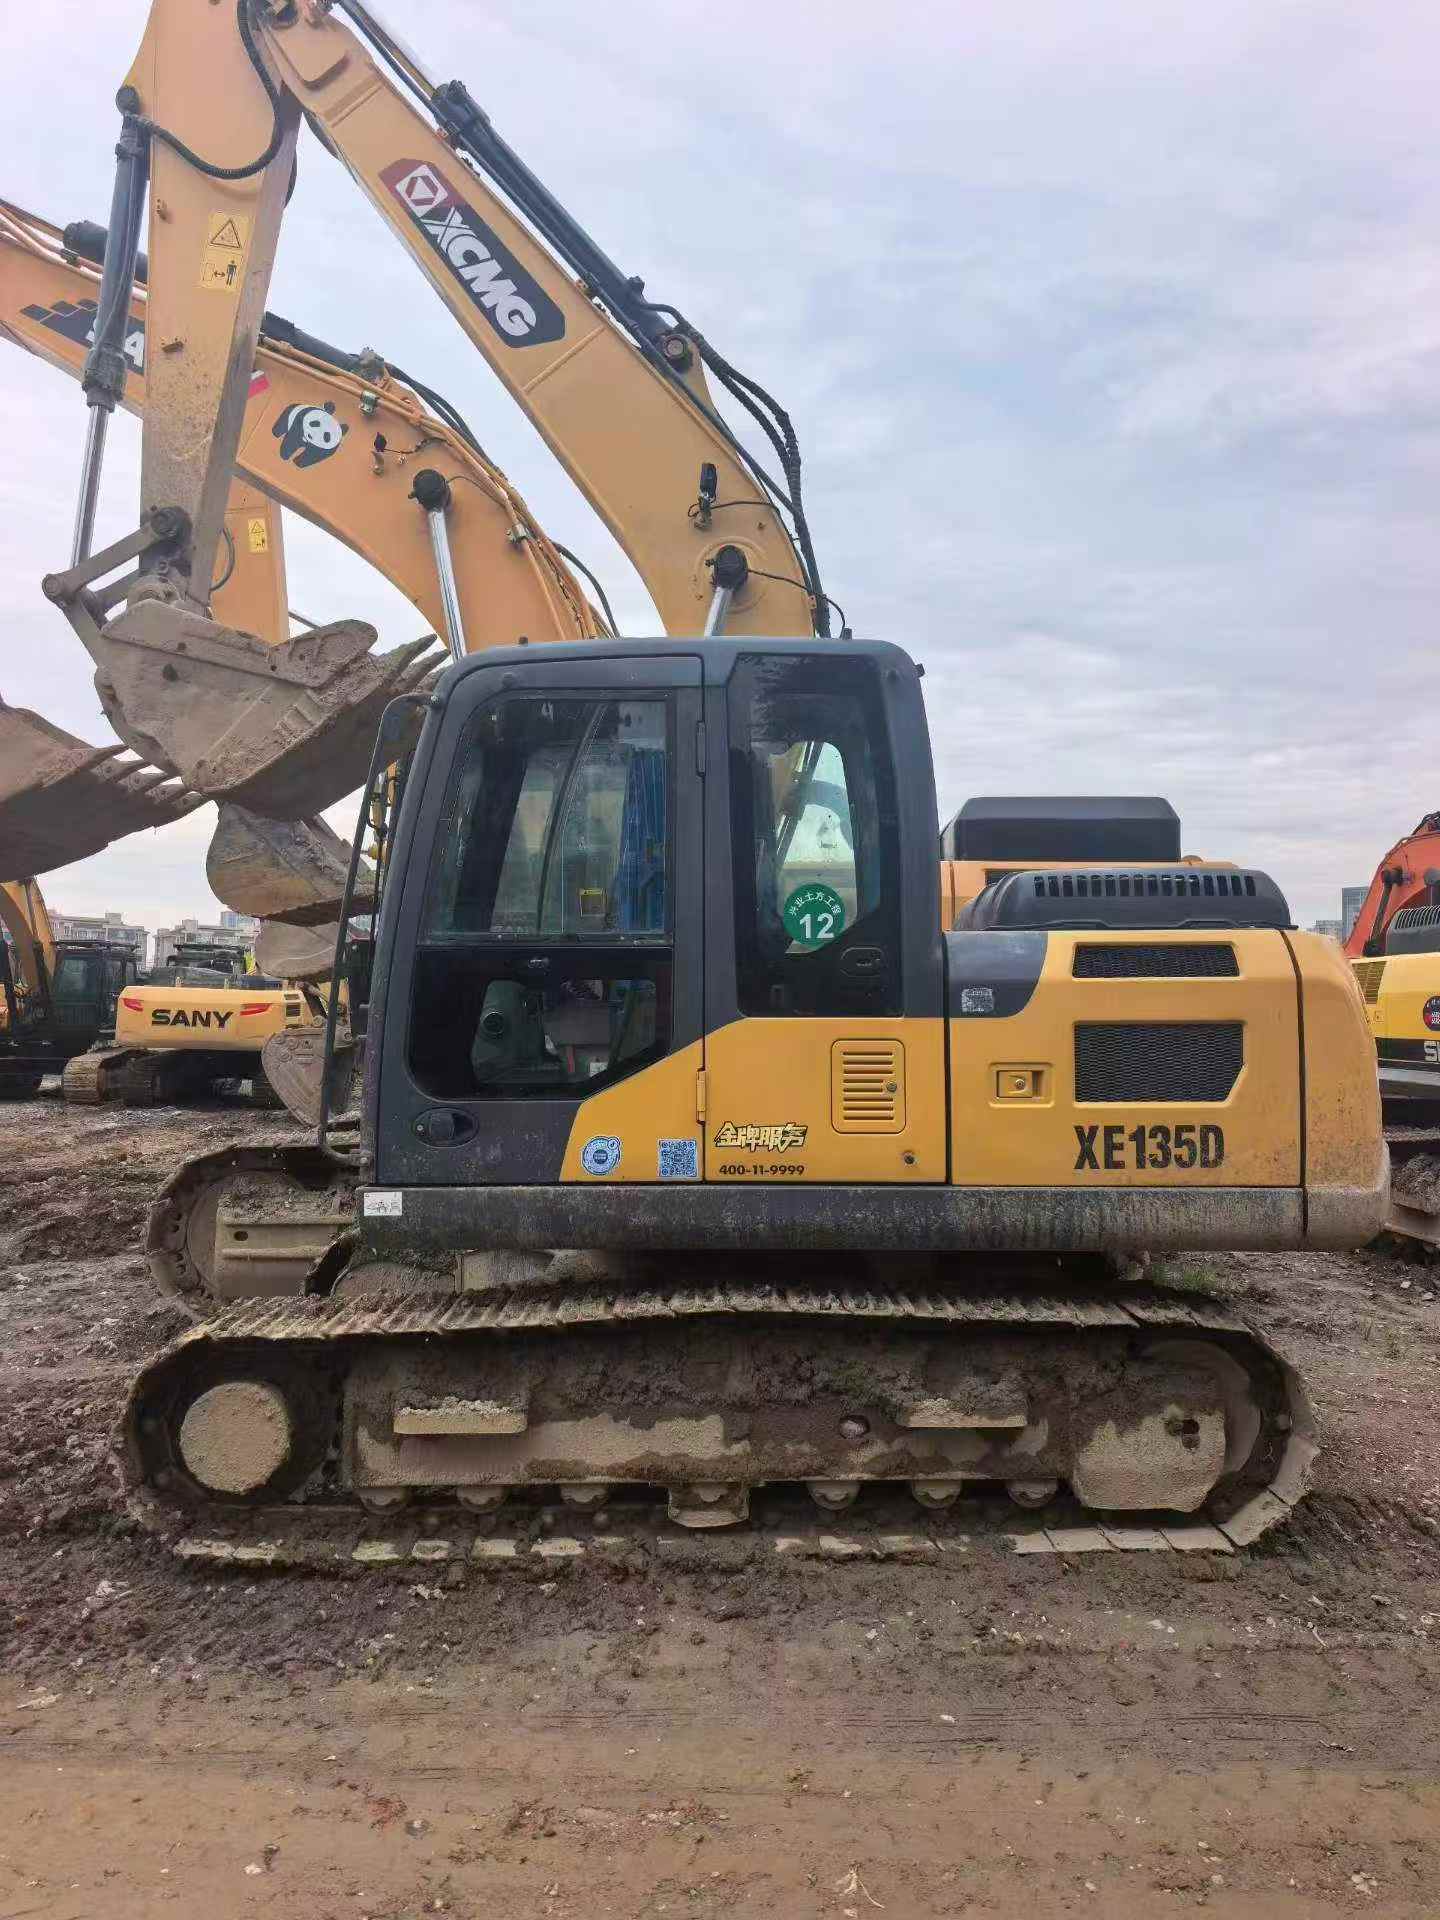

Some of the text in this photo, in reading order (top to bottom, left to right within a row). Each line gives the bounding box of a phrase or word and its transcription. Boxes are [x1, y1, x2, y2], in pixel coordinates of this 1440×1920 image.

[421, 206, 537, 336] XCMG
[800, 912, 834, 938] 12
[151, 1008, 234, 1028] SANY
[714, 1121, 808, 1153] 金牌服务
[1074, 1125, 1225, 1170] XE135D
[719, 1165, 805, 1175] 400-11-9999
